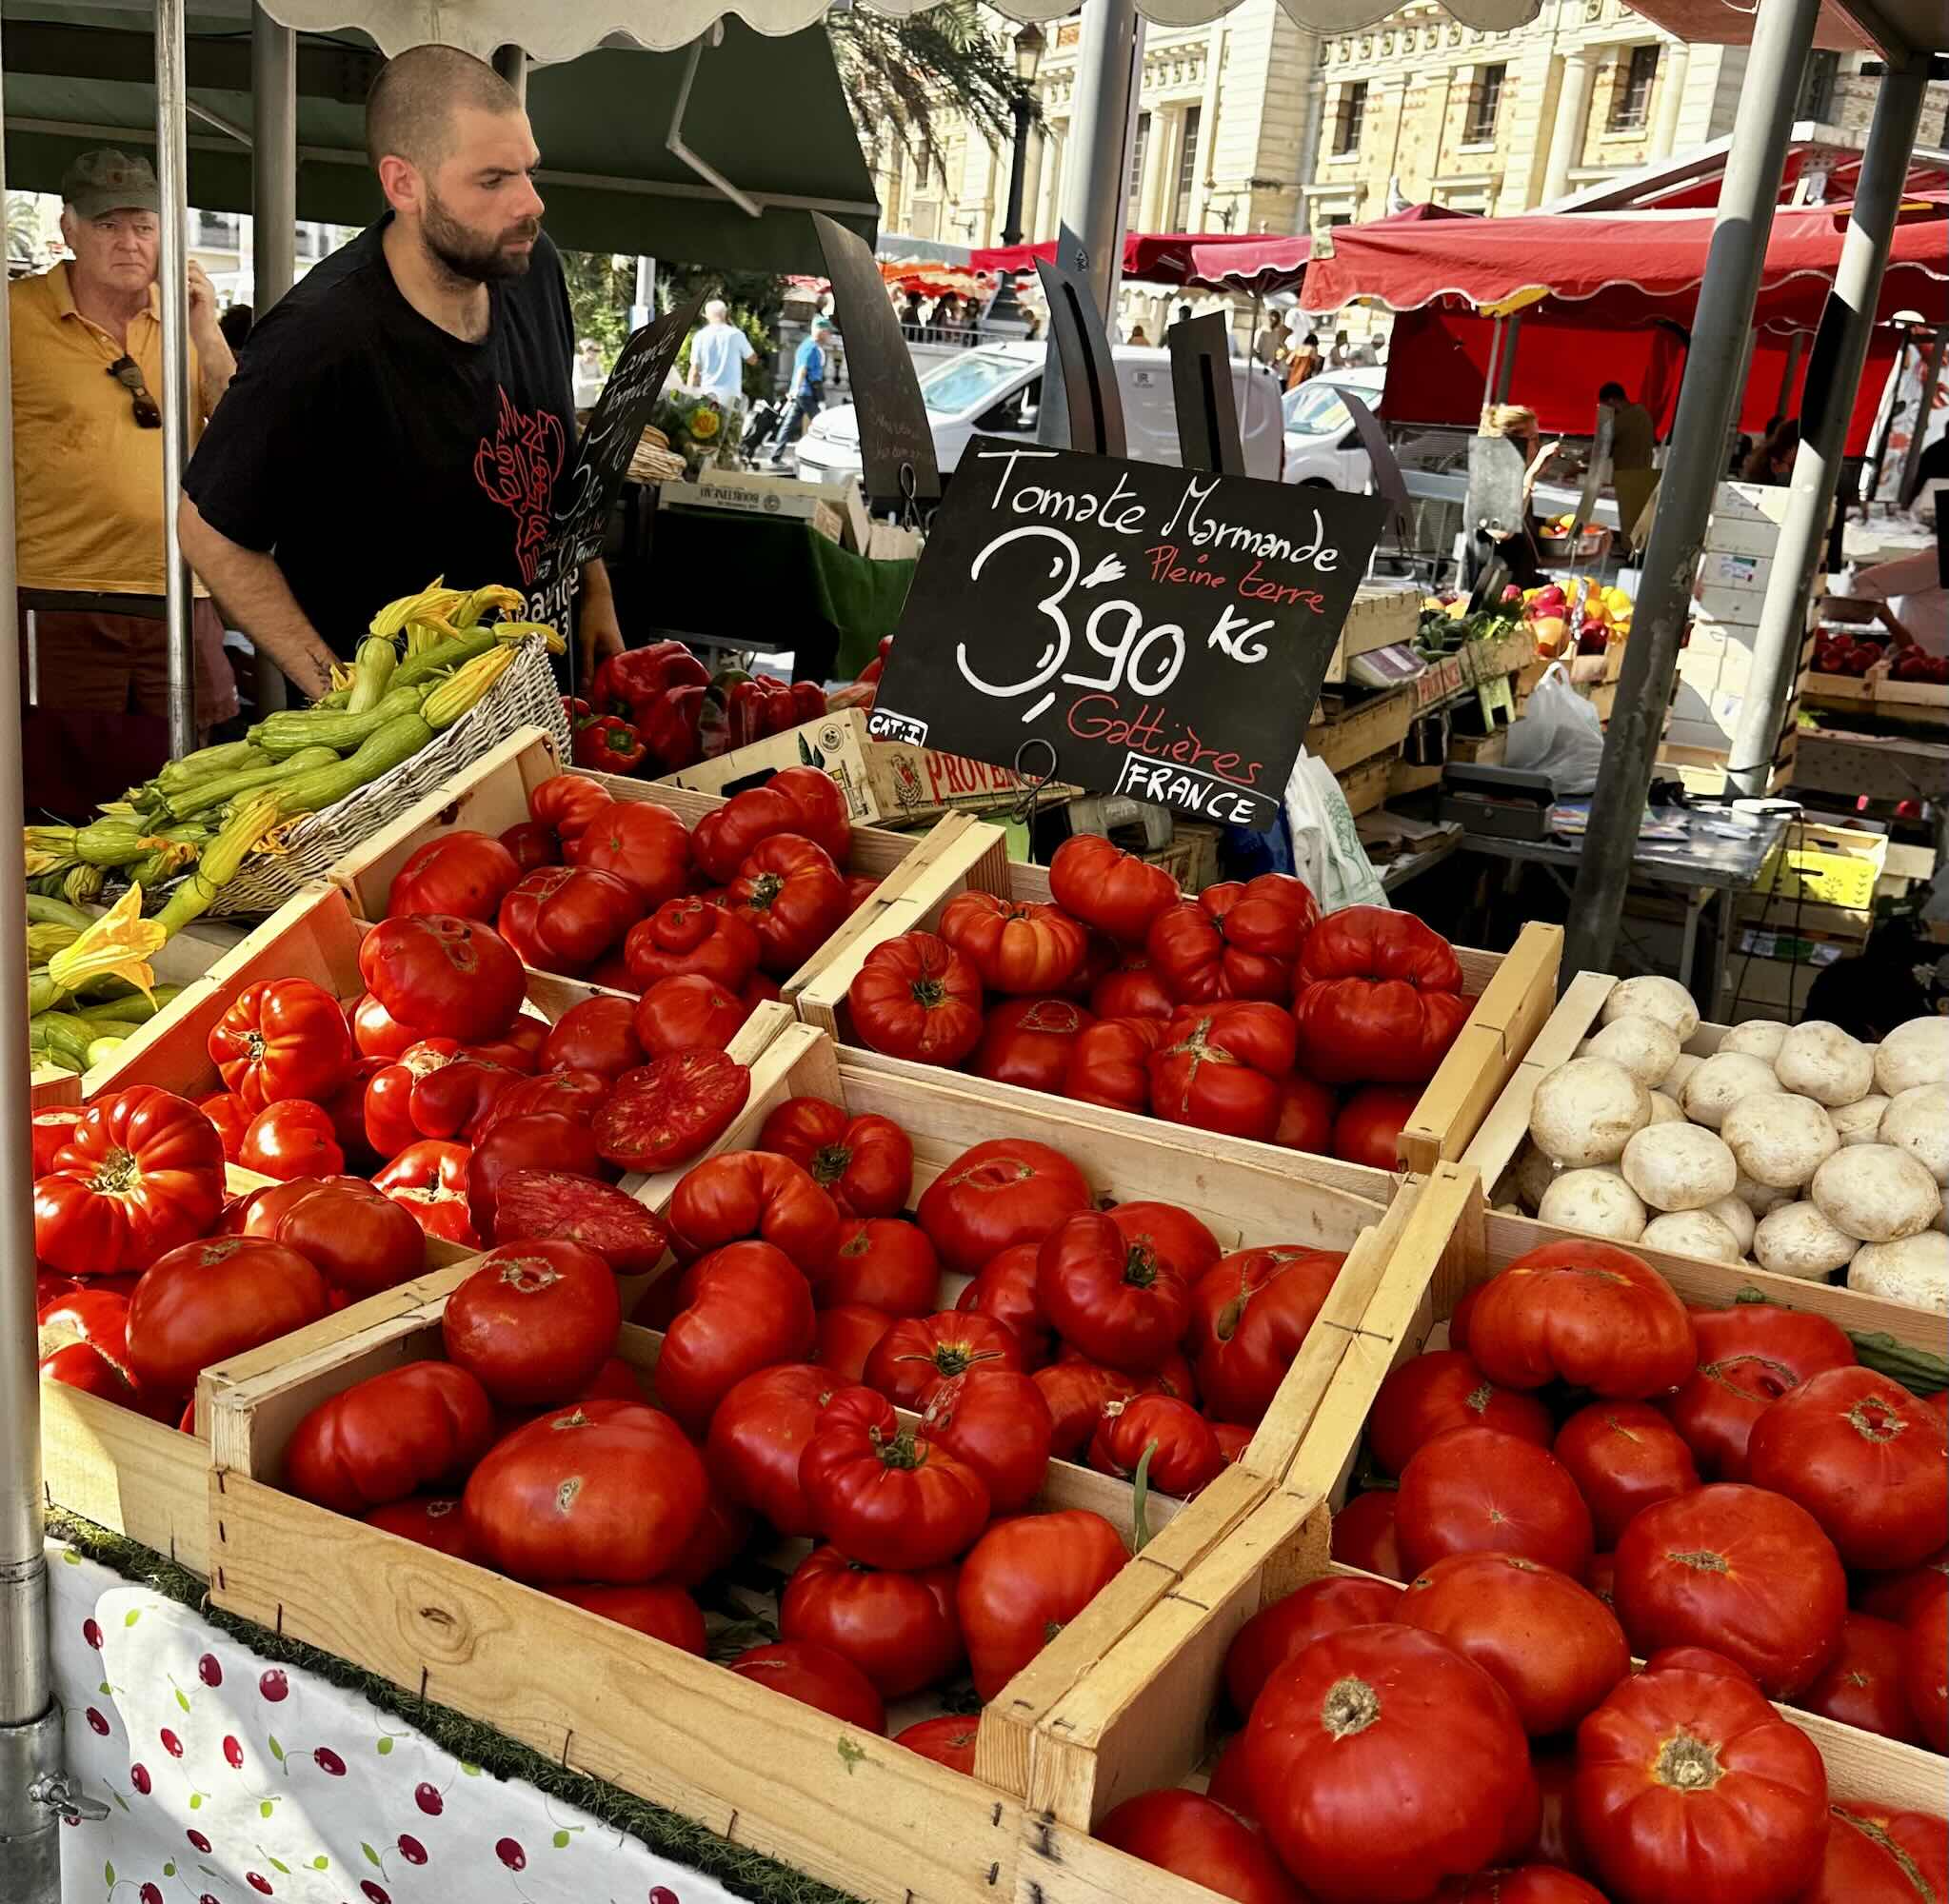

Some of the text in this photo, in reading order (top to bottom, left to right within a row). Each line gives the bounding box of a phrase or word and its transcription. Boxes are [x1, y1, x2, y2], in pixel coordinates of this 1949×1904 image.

[977, 448, 1339, 572] Tomate Marmande
[1144, 544, 1326, 614] Pleine terre
[1206, 603, 1275, 664] KG
[1065, 694, 1263, 786] Gattières
[1125, 762, 1256, 825] FRANCE
